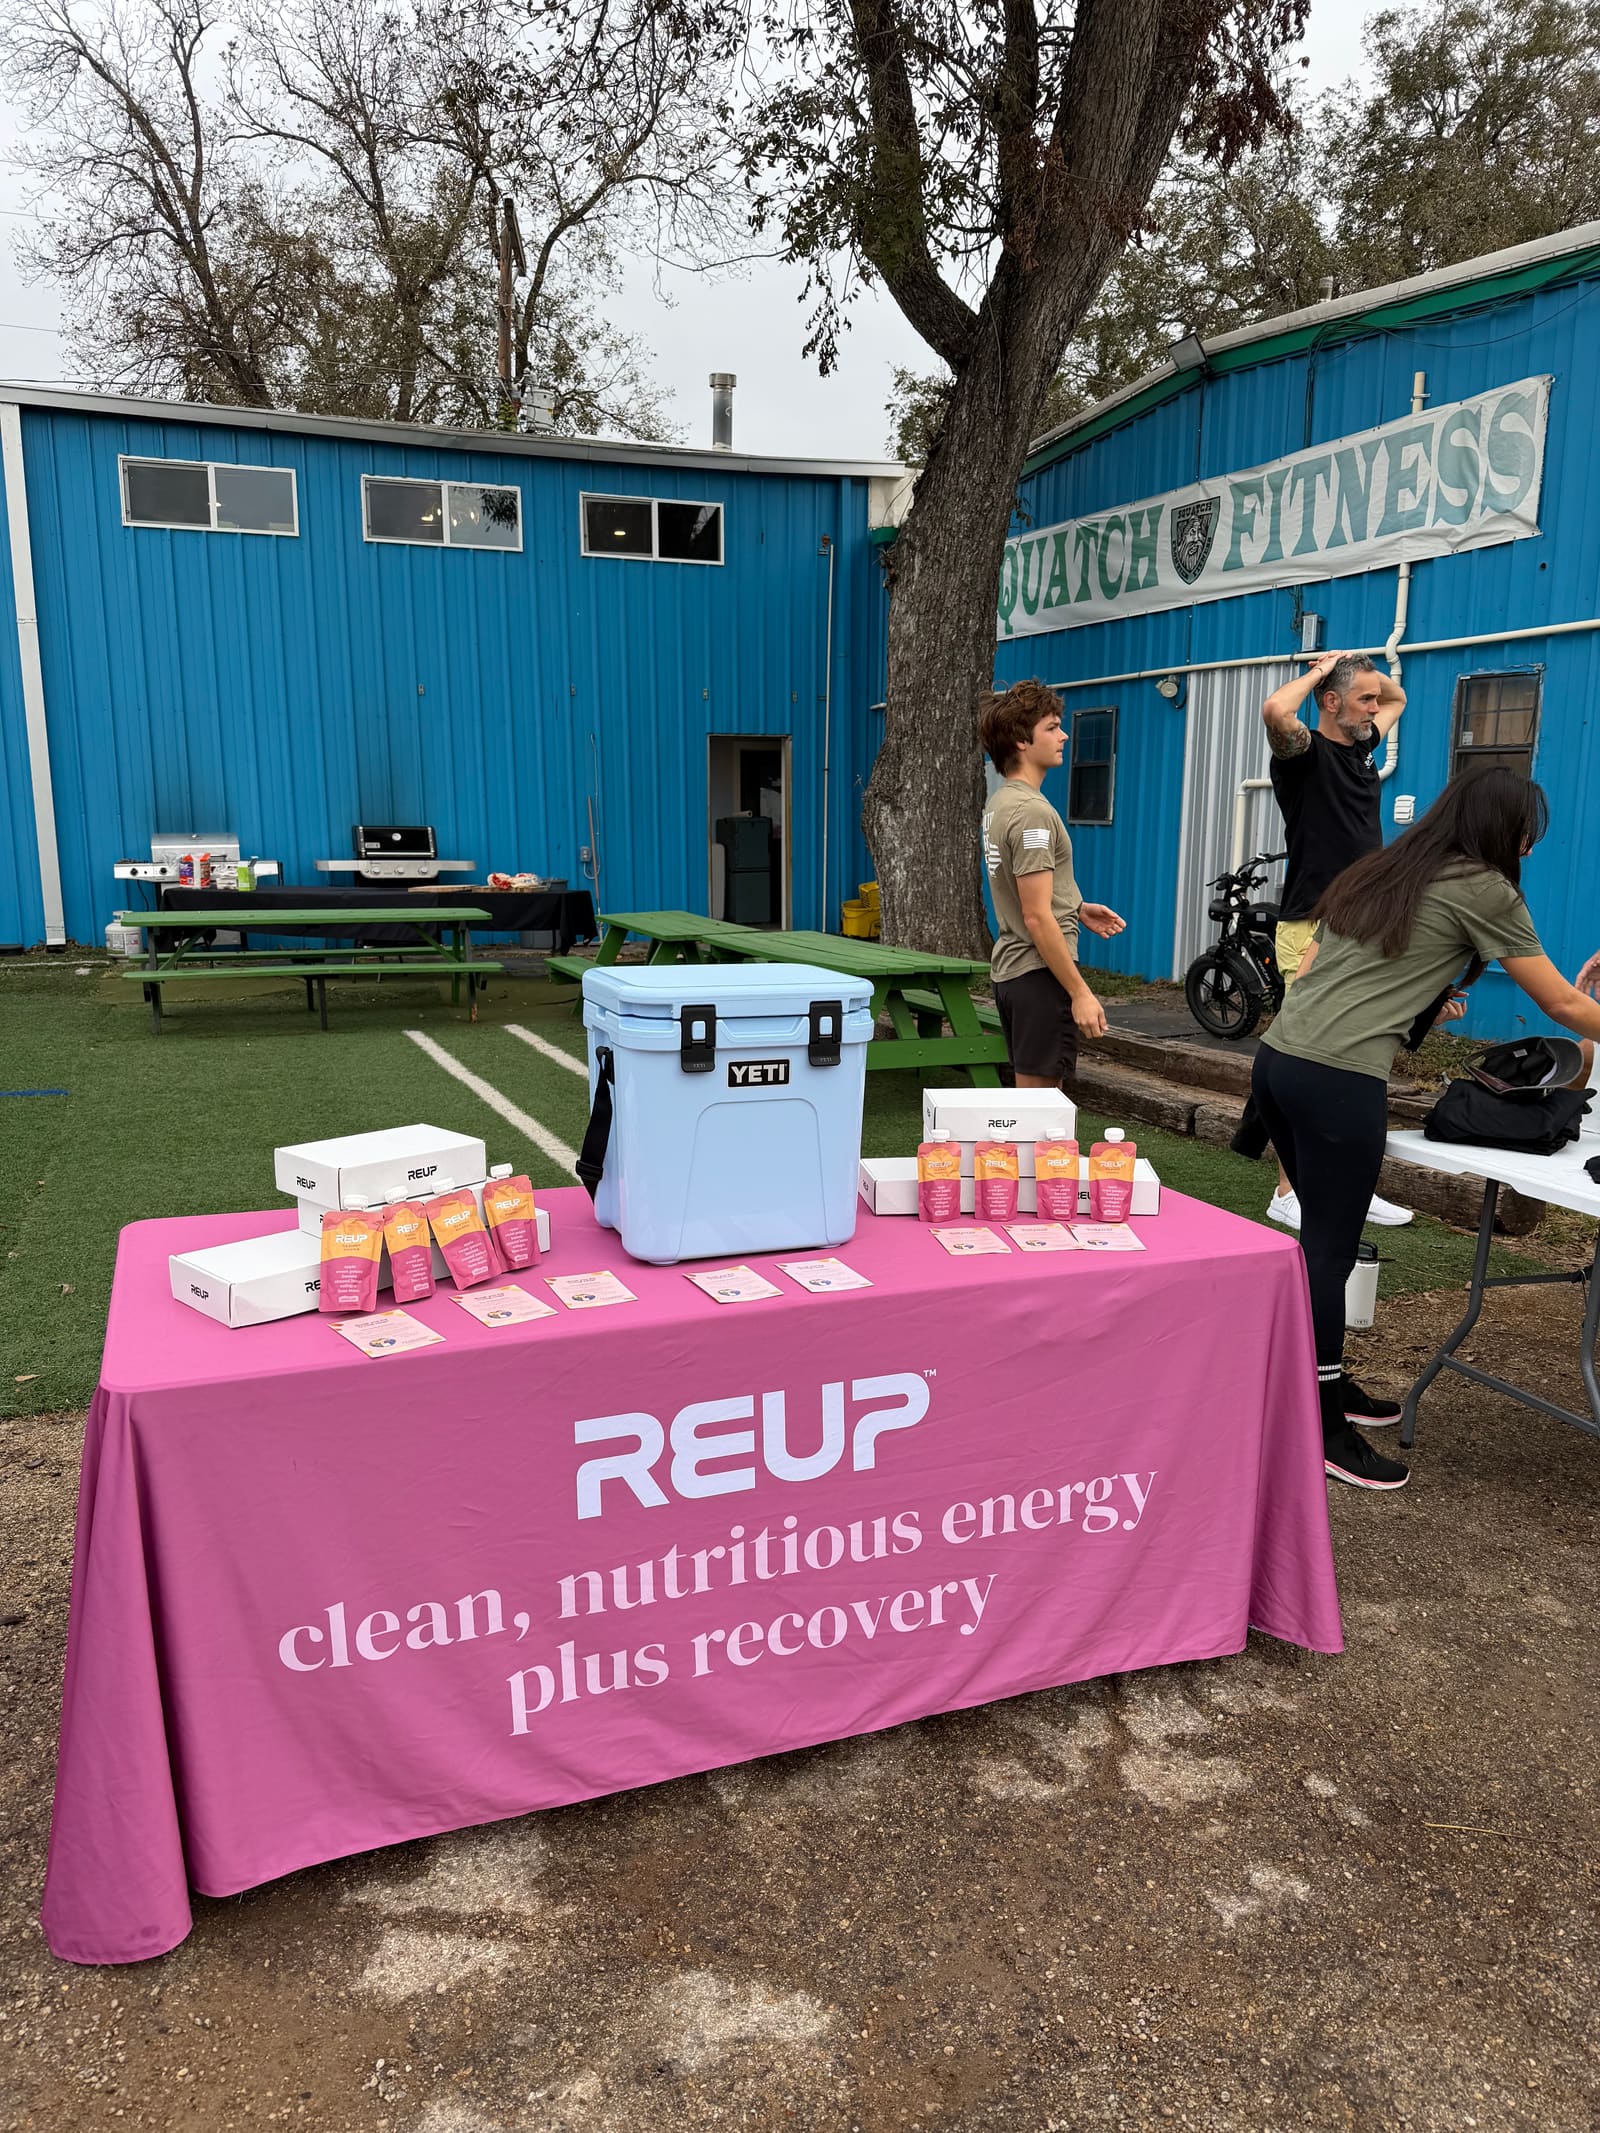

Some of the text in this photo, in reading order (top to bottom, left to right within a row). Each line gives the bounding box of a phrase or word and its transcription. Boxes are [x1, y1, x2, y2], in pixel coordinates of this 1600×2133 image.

[1222, 388, 1538, 572] FITNESS
[1178, 502, 1212, 519] SQUATCH
[730, 1064, 785, 1084] YETI
[988, 1119, 1017, 1128] REUP
[928, 1160, 952, 1168] REUP
[1047, 1159, 1070, 1167] REUP
[1100, 1160, 1125, 1168] REUP
[407, 1166, 437, 1180] REUP
[296, 1175, 316, 1190] REUP
[495, 1198, 520, 1209] REUP
[444, 1210, 471, 1227] REUP
[396, 1222, 419, 1234] REUP
[335, 1234, 368, 1243] REUP
[190, 1283, 209, 1300] REUP
[278, 1470, 1158, 1672] clean, nutritious energy
[506, 1574, 998, 1736] plus recovery
